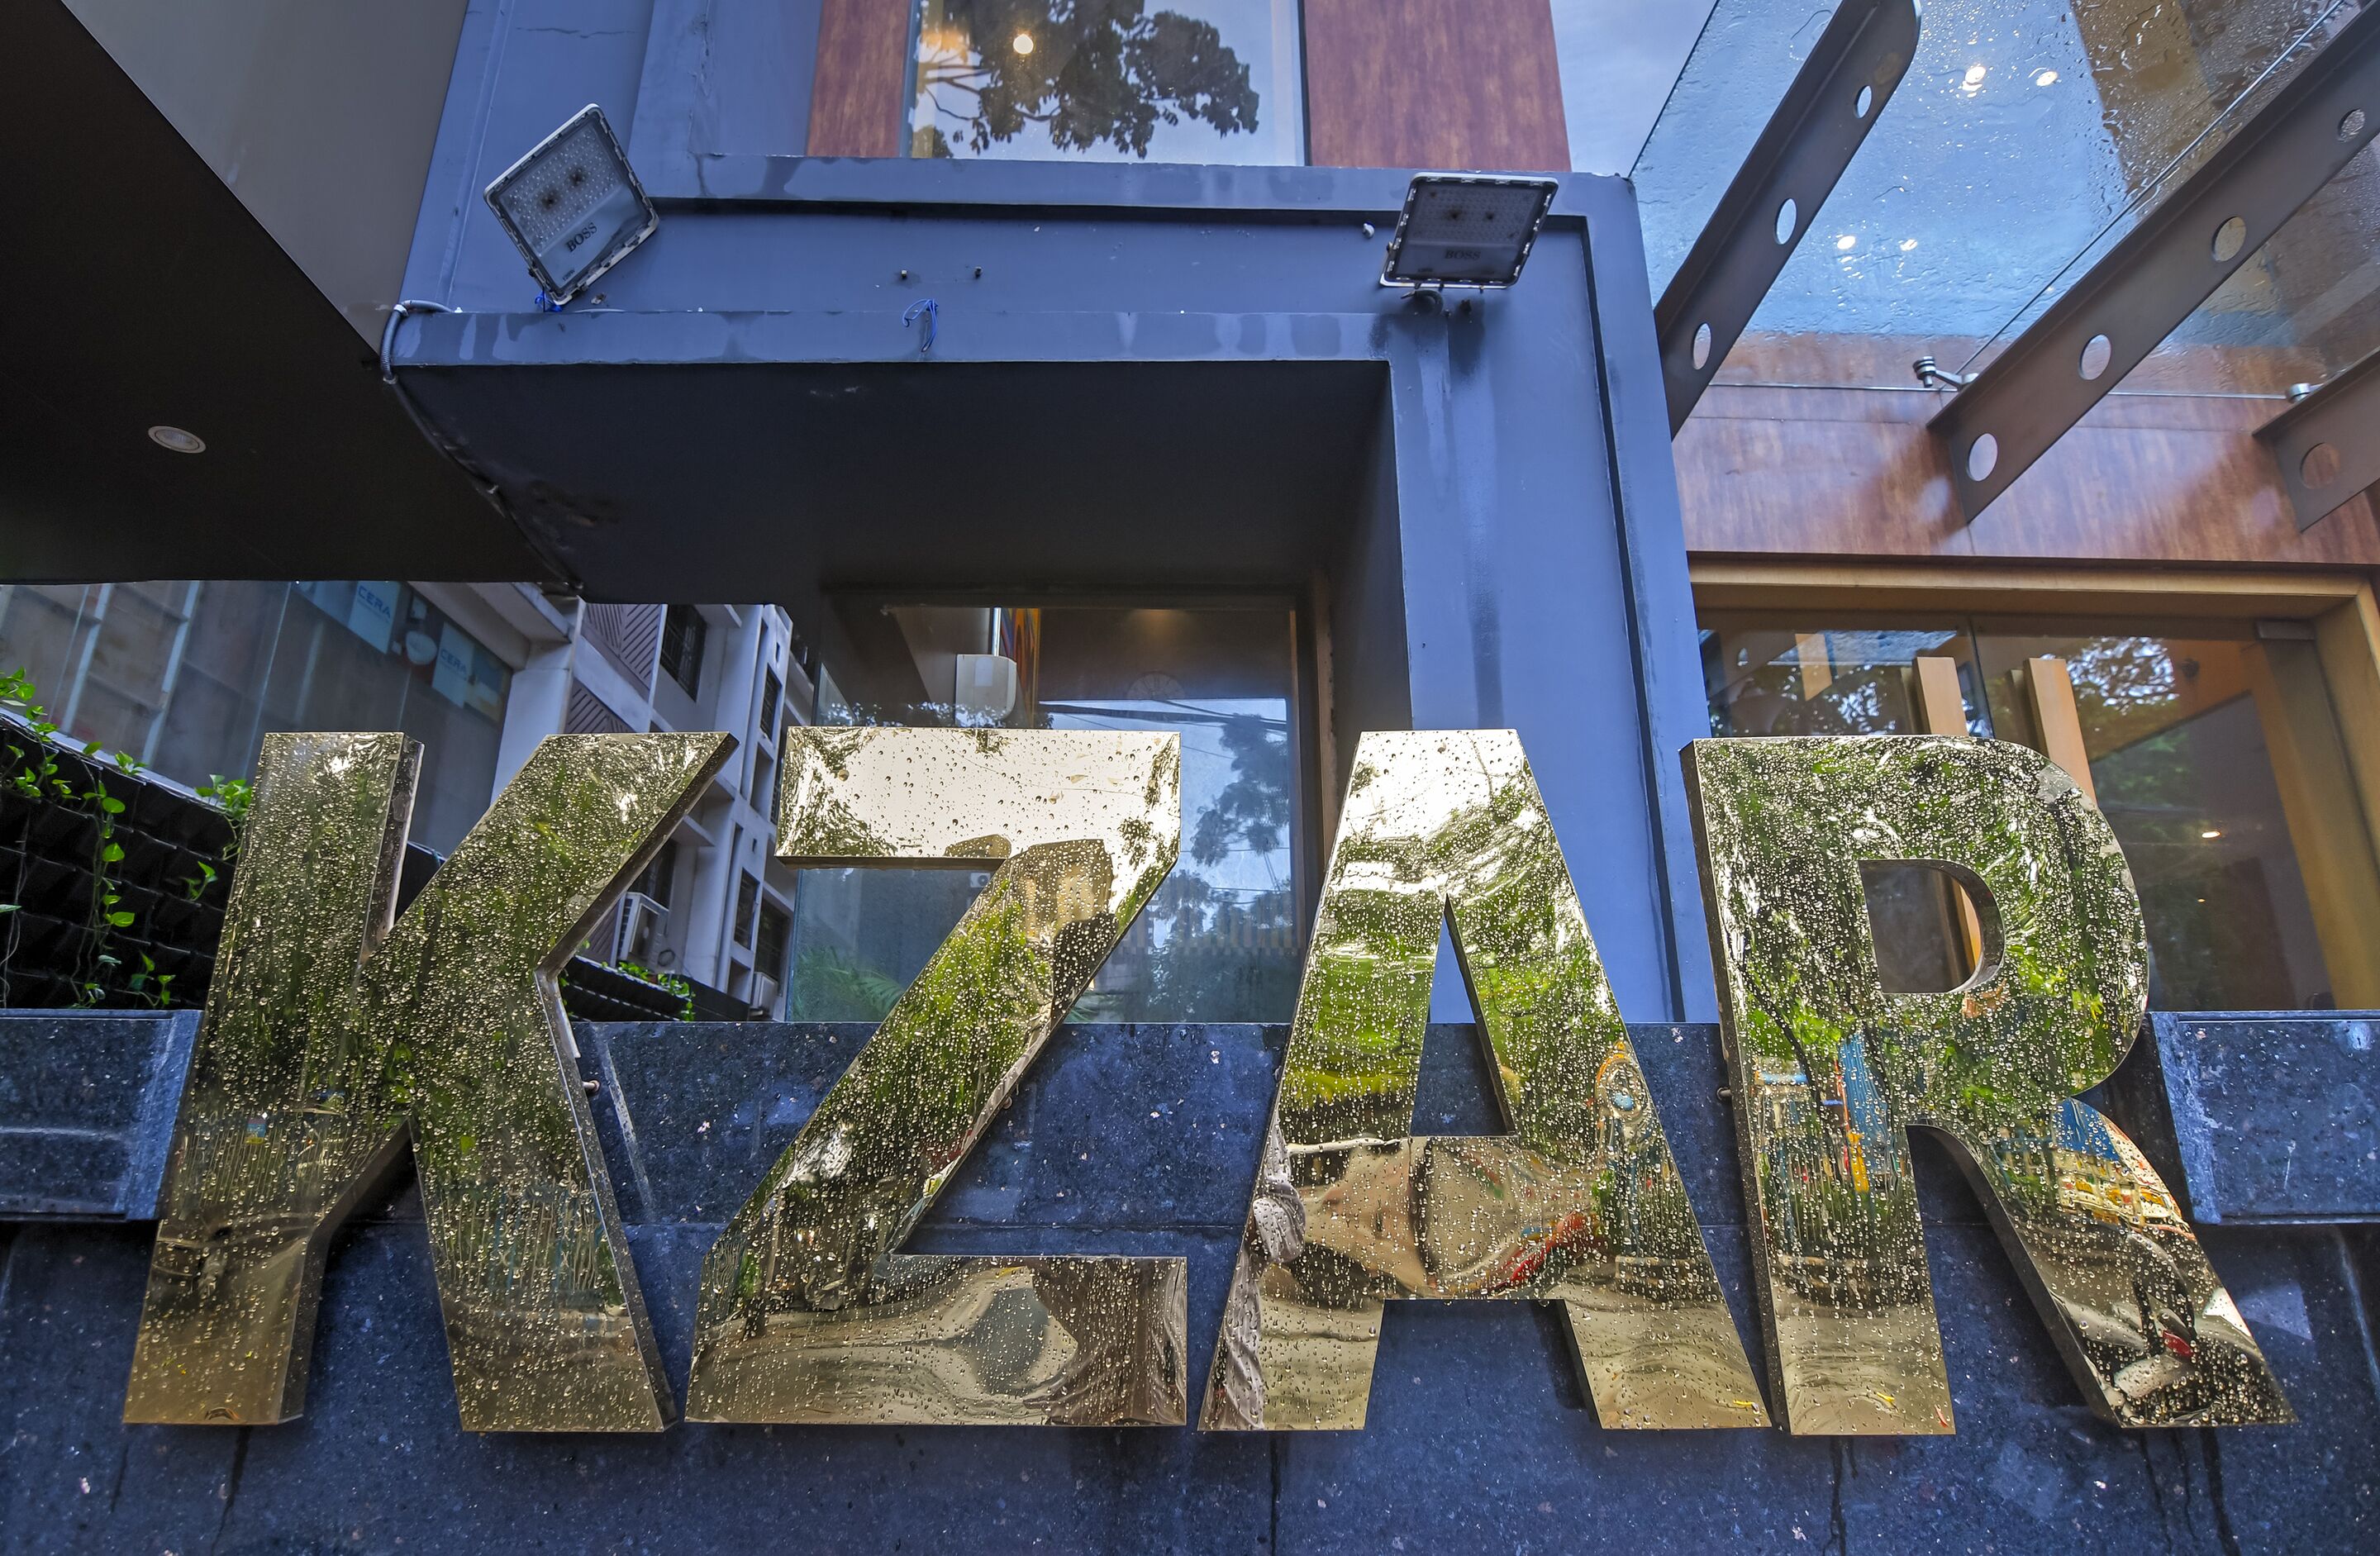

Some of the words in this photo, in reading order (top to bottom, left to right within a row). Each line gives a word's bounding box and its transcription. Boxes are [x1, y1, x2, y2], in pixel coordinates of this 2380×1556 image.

[566, 222, 597, 252] BOSS
[1445, 250, 1481, 259] BOSS
[358, 585, 391, 618] CERA
[440, 649, 467, 674] CERA
[122, 726, 2299, 1436] KZAR
